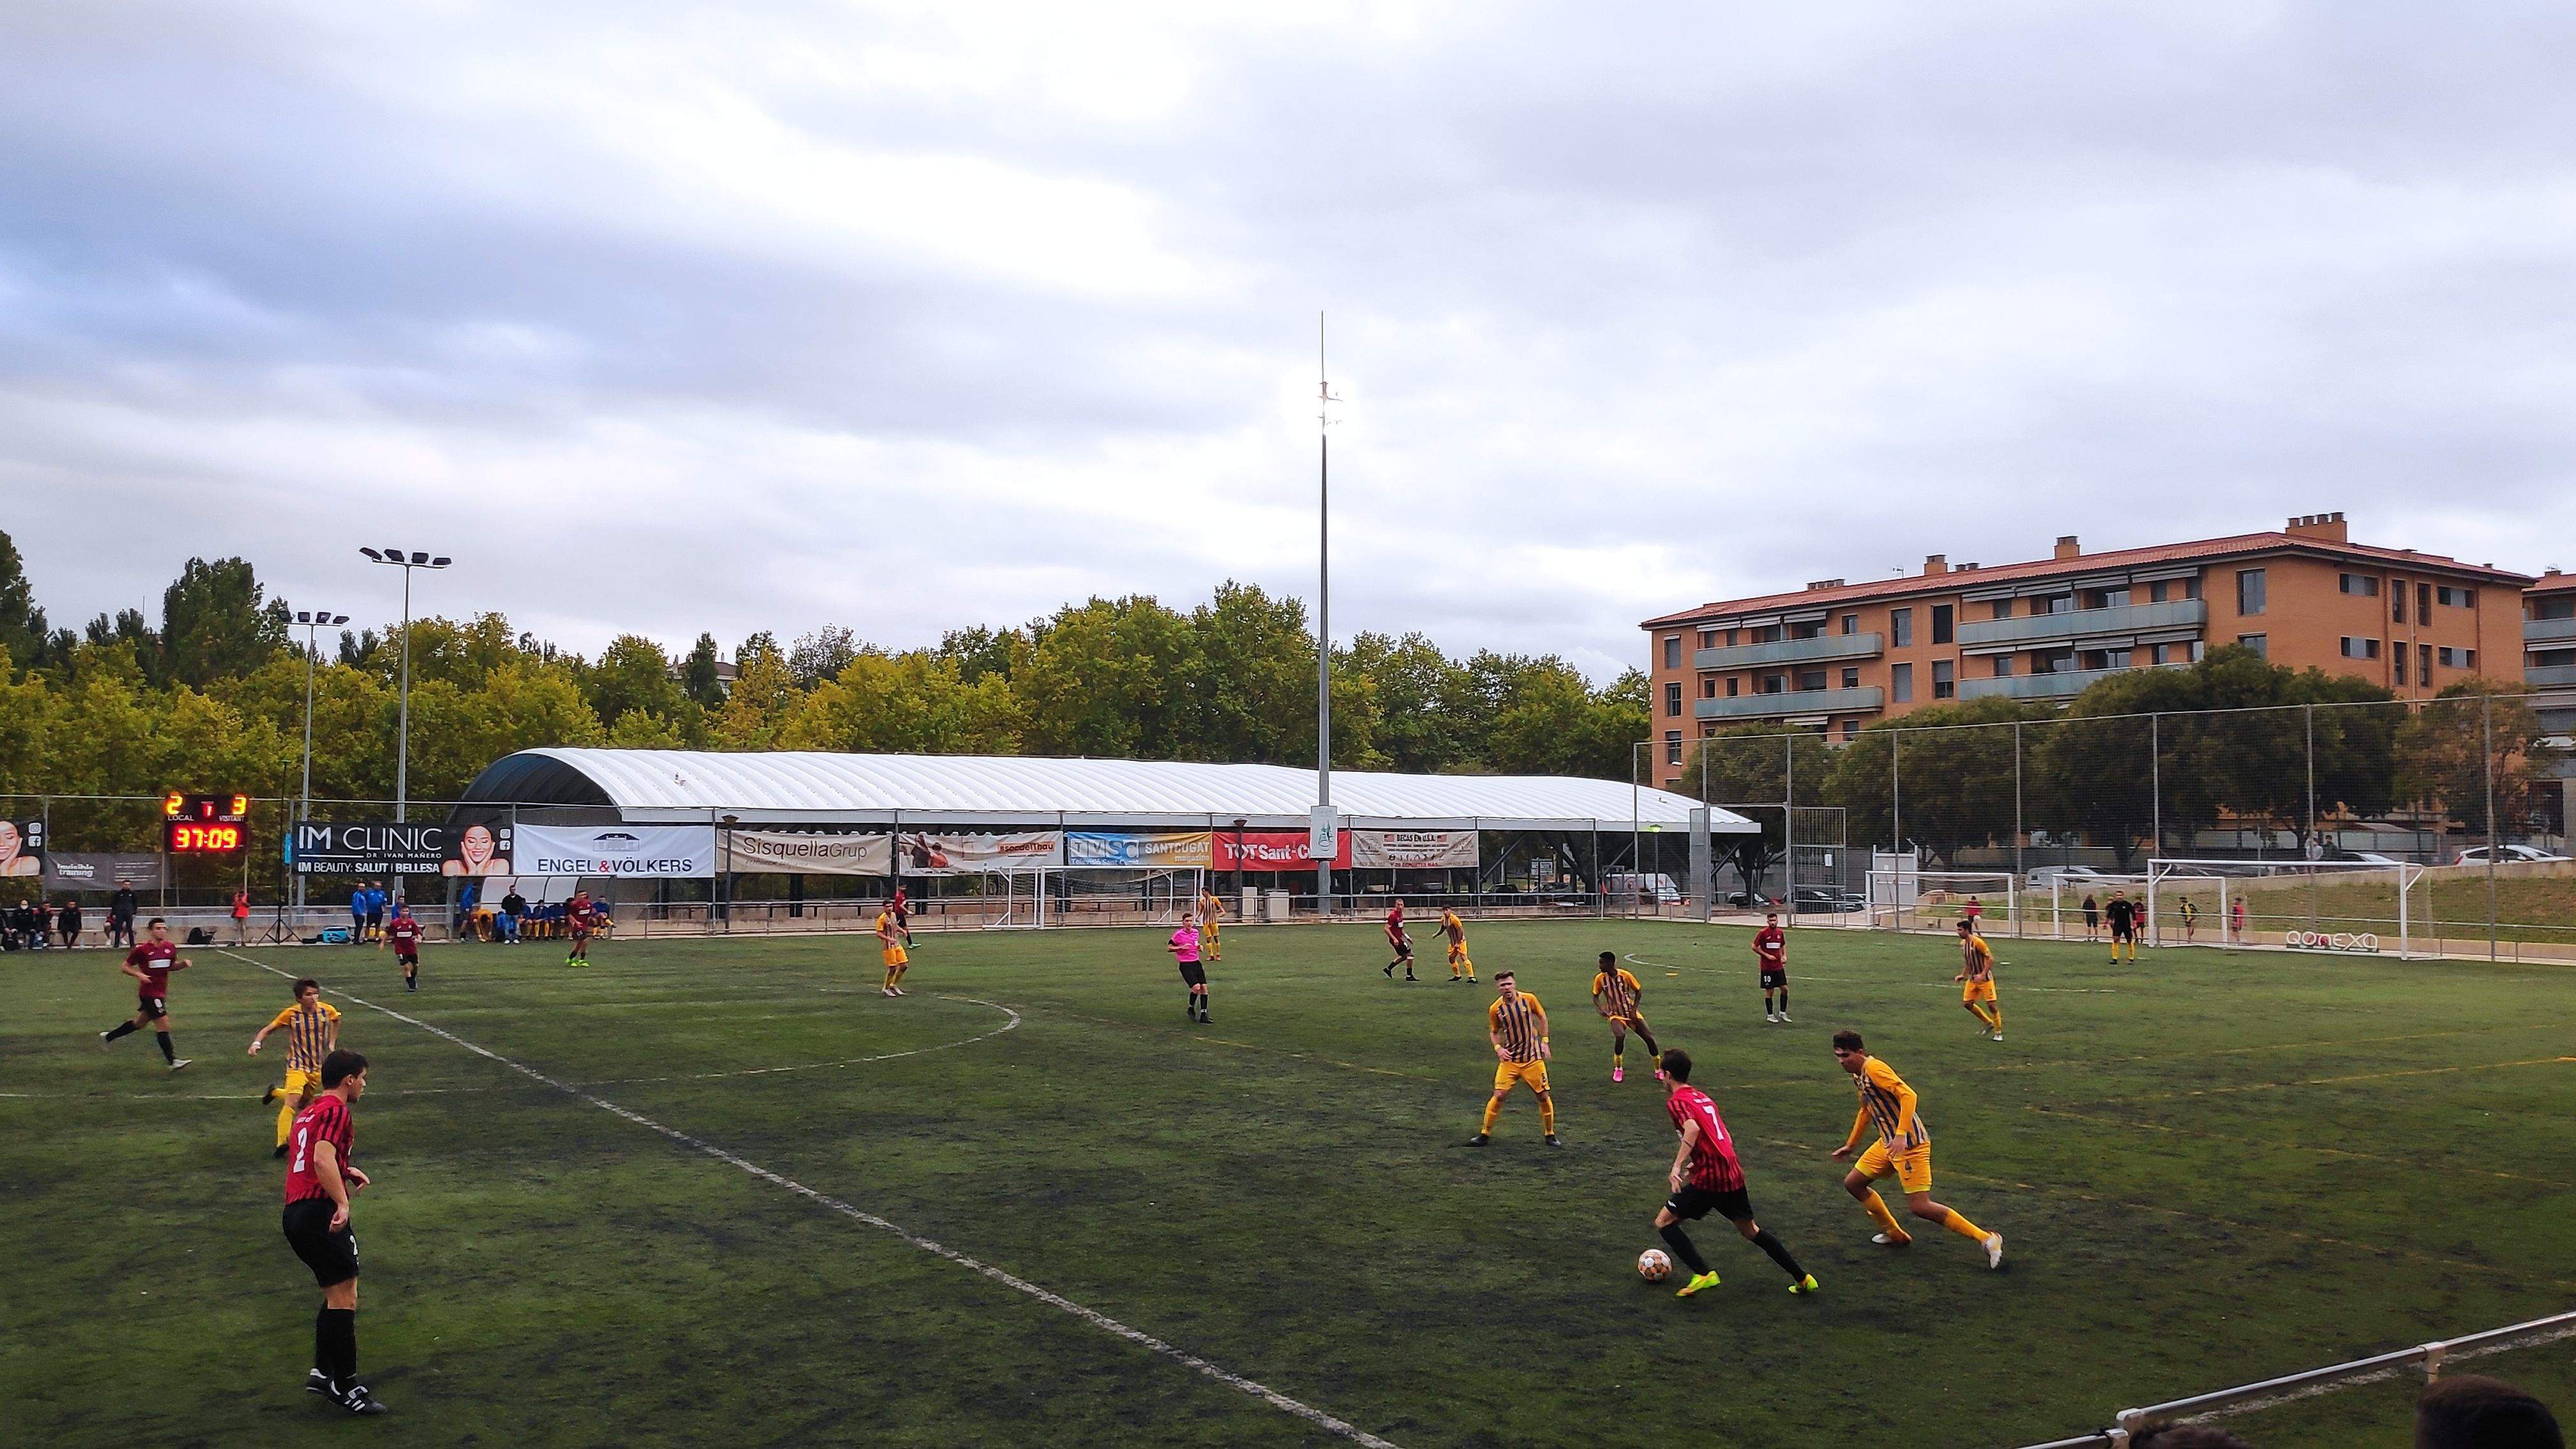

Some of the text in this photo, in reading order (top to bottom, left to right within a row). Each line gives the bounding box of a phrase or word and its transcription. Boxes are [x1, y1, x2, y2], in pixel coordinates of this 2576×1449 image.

[167, 795, 183, 815] 2
[233, 797, 247, 815] 3
[176, 829, 237, 848] 37:09
[298, 826, 442, 851] IM CLINIC
[744, 837, 868, 861] SisquellaGrup
[1258, 844, 1292, 859] Sant
[298, 862, 311, 873] IM
[314, 862, 353, 873] BEAUTY:
[355, 863, 388, 873] SALUT
[395, 863, 440, 873] BELLESA
[1703, 1105, 1724, 1140] 7
[293, 1127, 307, 1173] 2
